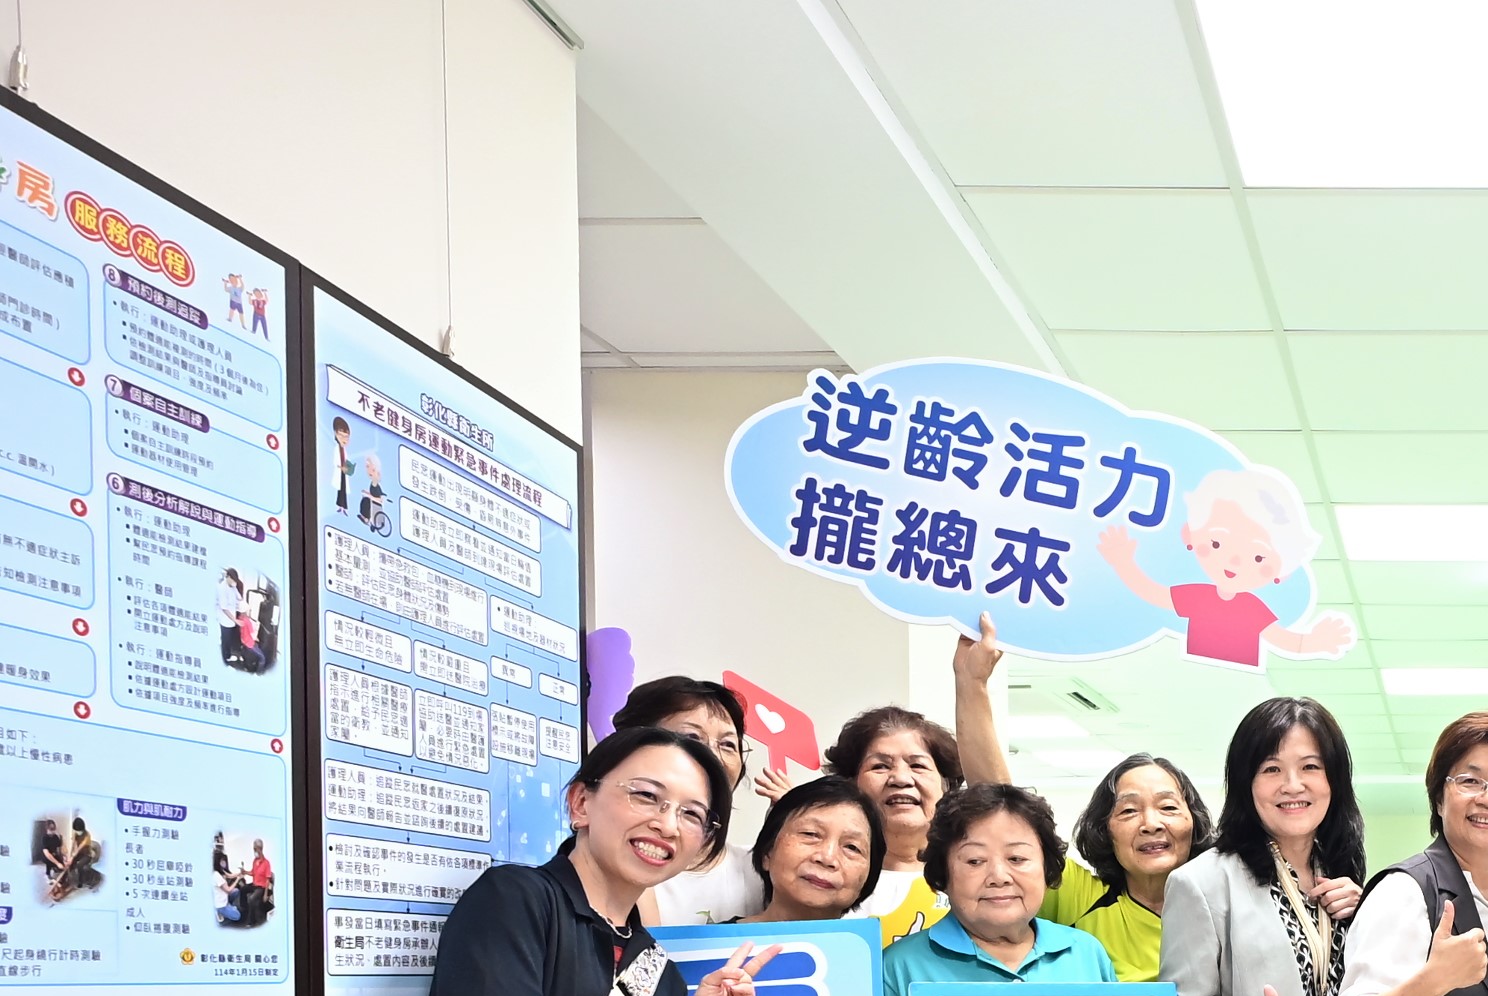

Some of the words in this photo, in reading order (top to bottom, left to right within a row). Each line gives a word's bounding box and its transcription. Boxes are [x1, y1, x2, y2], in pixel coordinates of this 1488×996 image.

[16, 159, 56, 220] 房
[73, 195, 188, 282] 服務流程
[107, 267, 115, 282] 8
[127, 275, 201, 326] 預約後測追蹤
[109, 377, 117, 392] 7
[129, 384, 202, 429] 個案自主訓練
[419, 390, 494, 453] 彰化縣衛生所
[357, 389, 542, 508] 不老健身房運動緊急事件處理流程
[802, 375, 1172, 528] 逆齡活力
[111, 477, 119, 489] 6
[128, 481, 257, 539] 測後分析解說與運動指導
[789, 478, 1071, 608] 攏總來
[0, 567, 81, 597] 知檢測注意事項
[122, 799, 183, 819] 肌力與肌耐力
[125, 906, 145, 918] 成人
[335, 876, 467, 901] 針對問題及實際狀況進行確實的改
